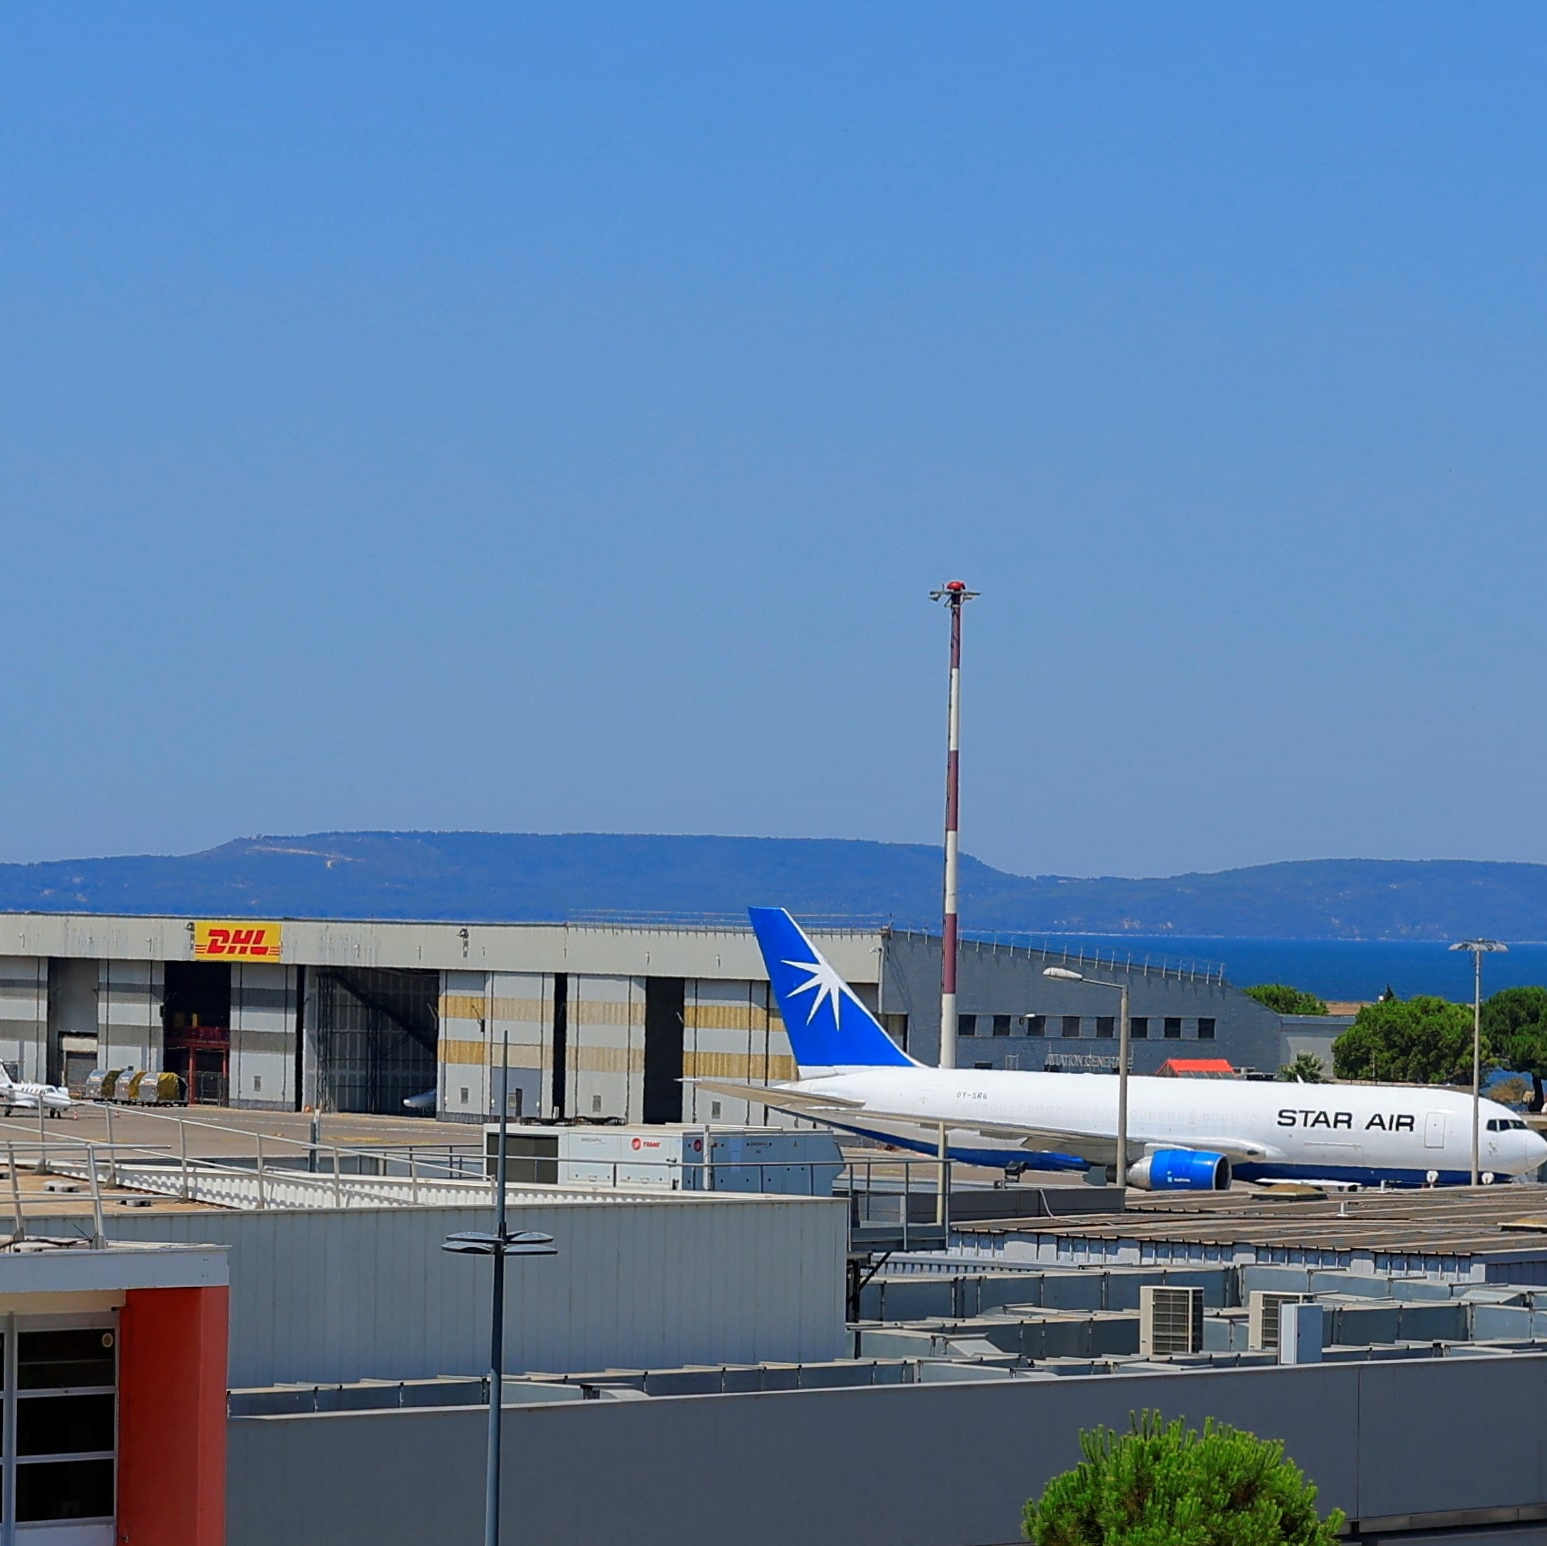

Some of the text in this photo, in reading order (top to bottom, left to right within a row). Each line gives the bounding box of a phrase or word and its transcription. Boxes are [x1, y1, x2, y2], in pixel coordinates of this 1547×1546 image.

[206, 929, 269, 956] DHL
[1083, 1055, 1134, 1069] GENERAE
[1277, 1109, 1415, 1132] STAR AIR
